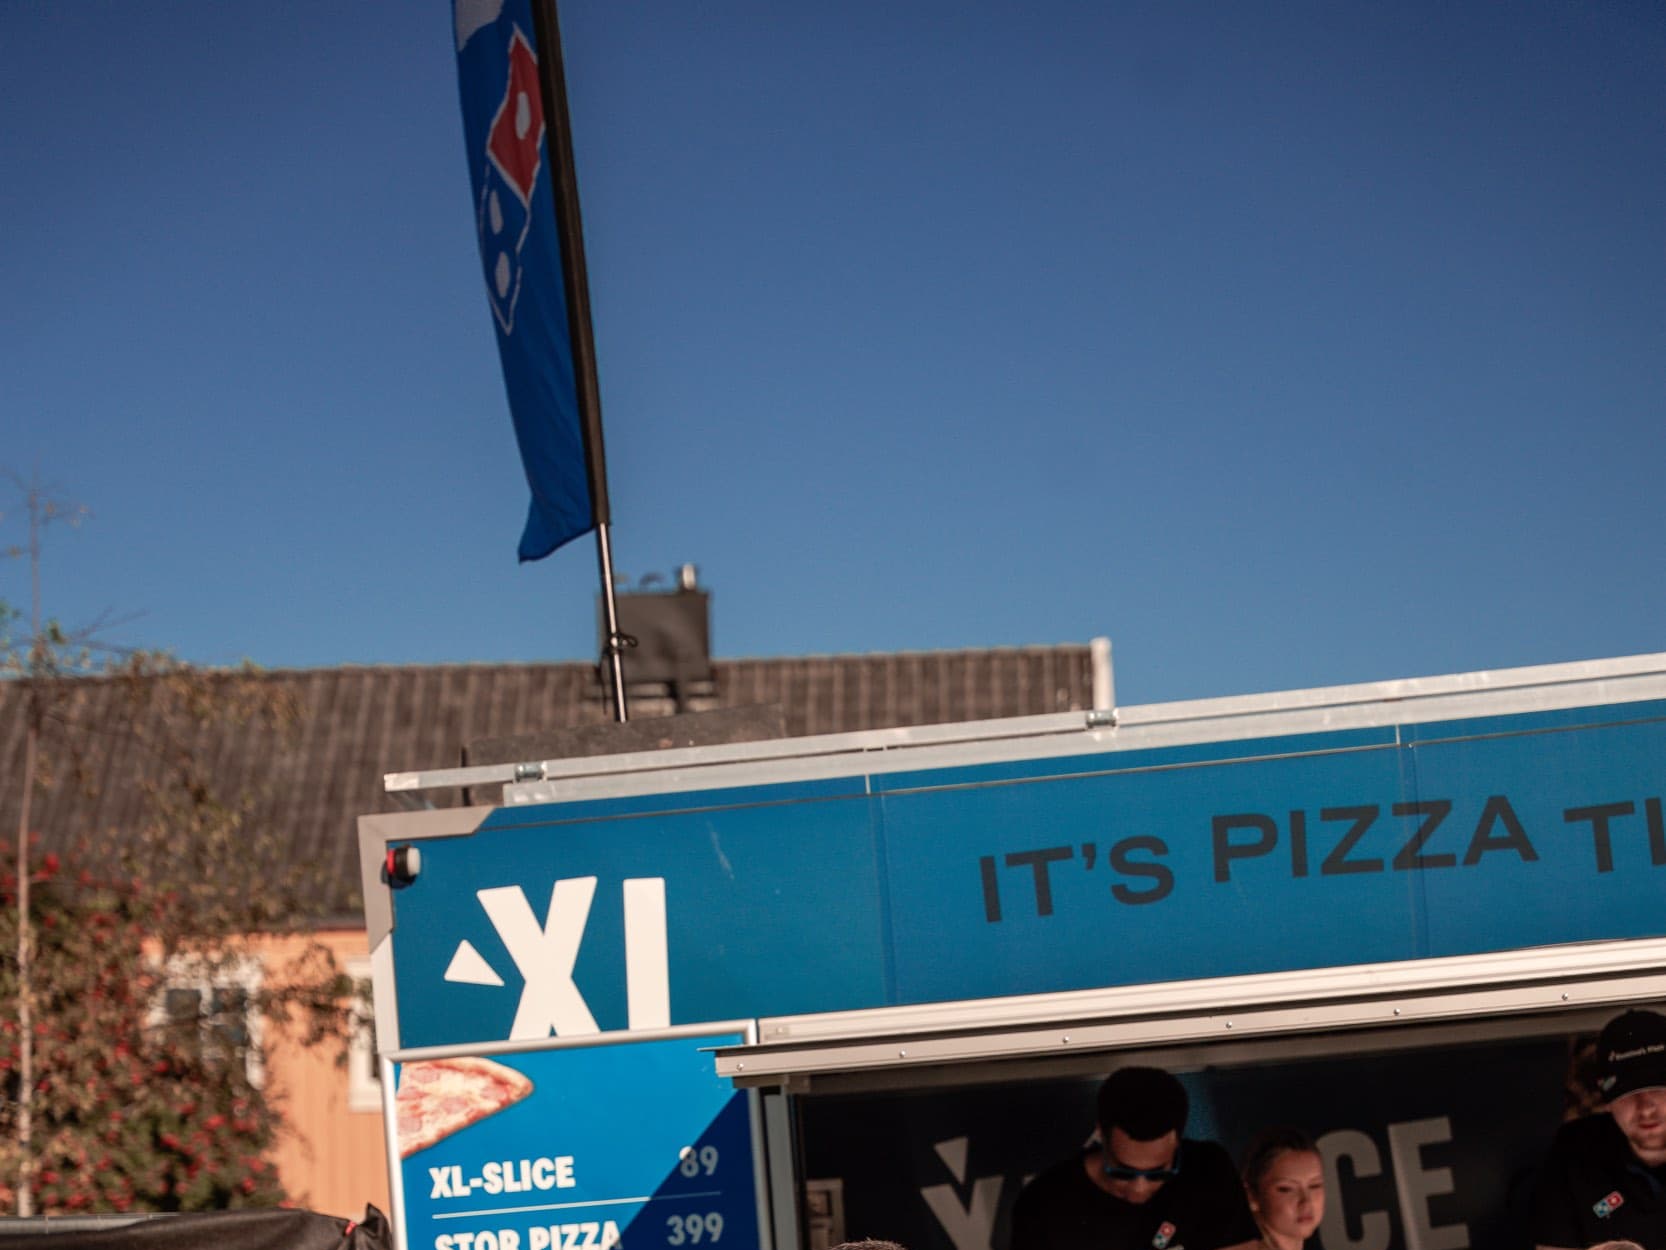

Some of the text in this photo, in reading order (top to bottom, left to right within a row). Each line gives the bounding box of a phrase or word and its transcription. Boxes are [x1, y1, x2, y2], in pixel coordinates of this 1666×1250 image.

[978, 834, 1176, 924] IT'S
[1211, 795, 1540, 883] PIZZA
[429, 1146, 718, 1200] XL-SLICE 89
[667, 1212, 724, 1246] 399
